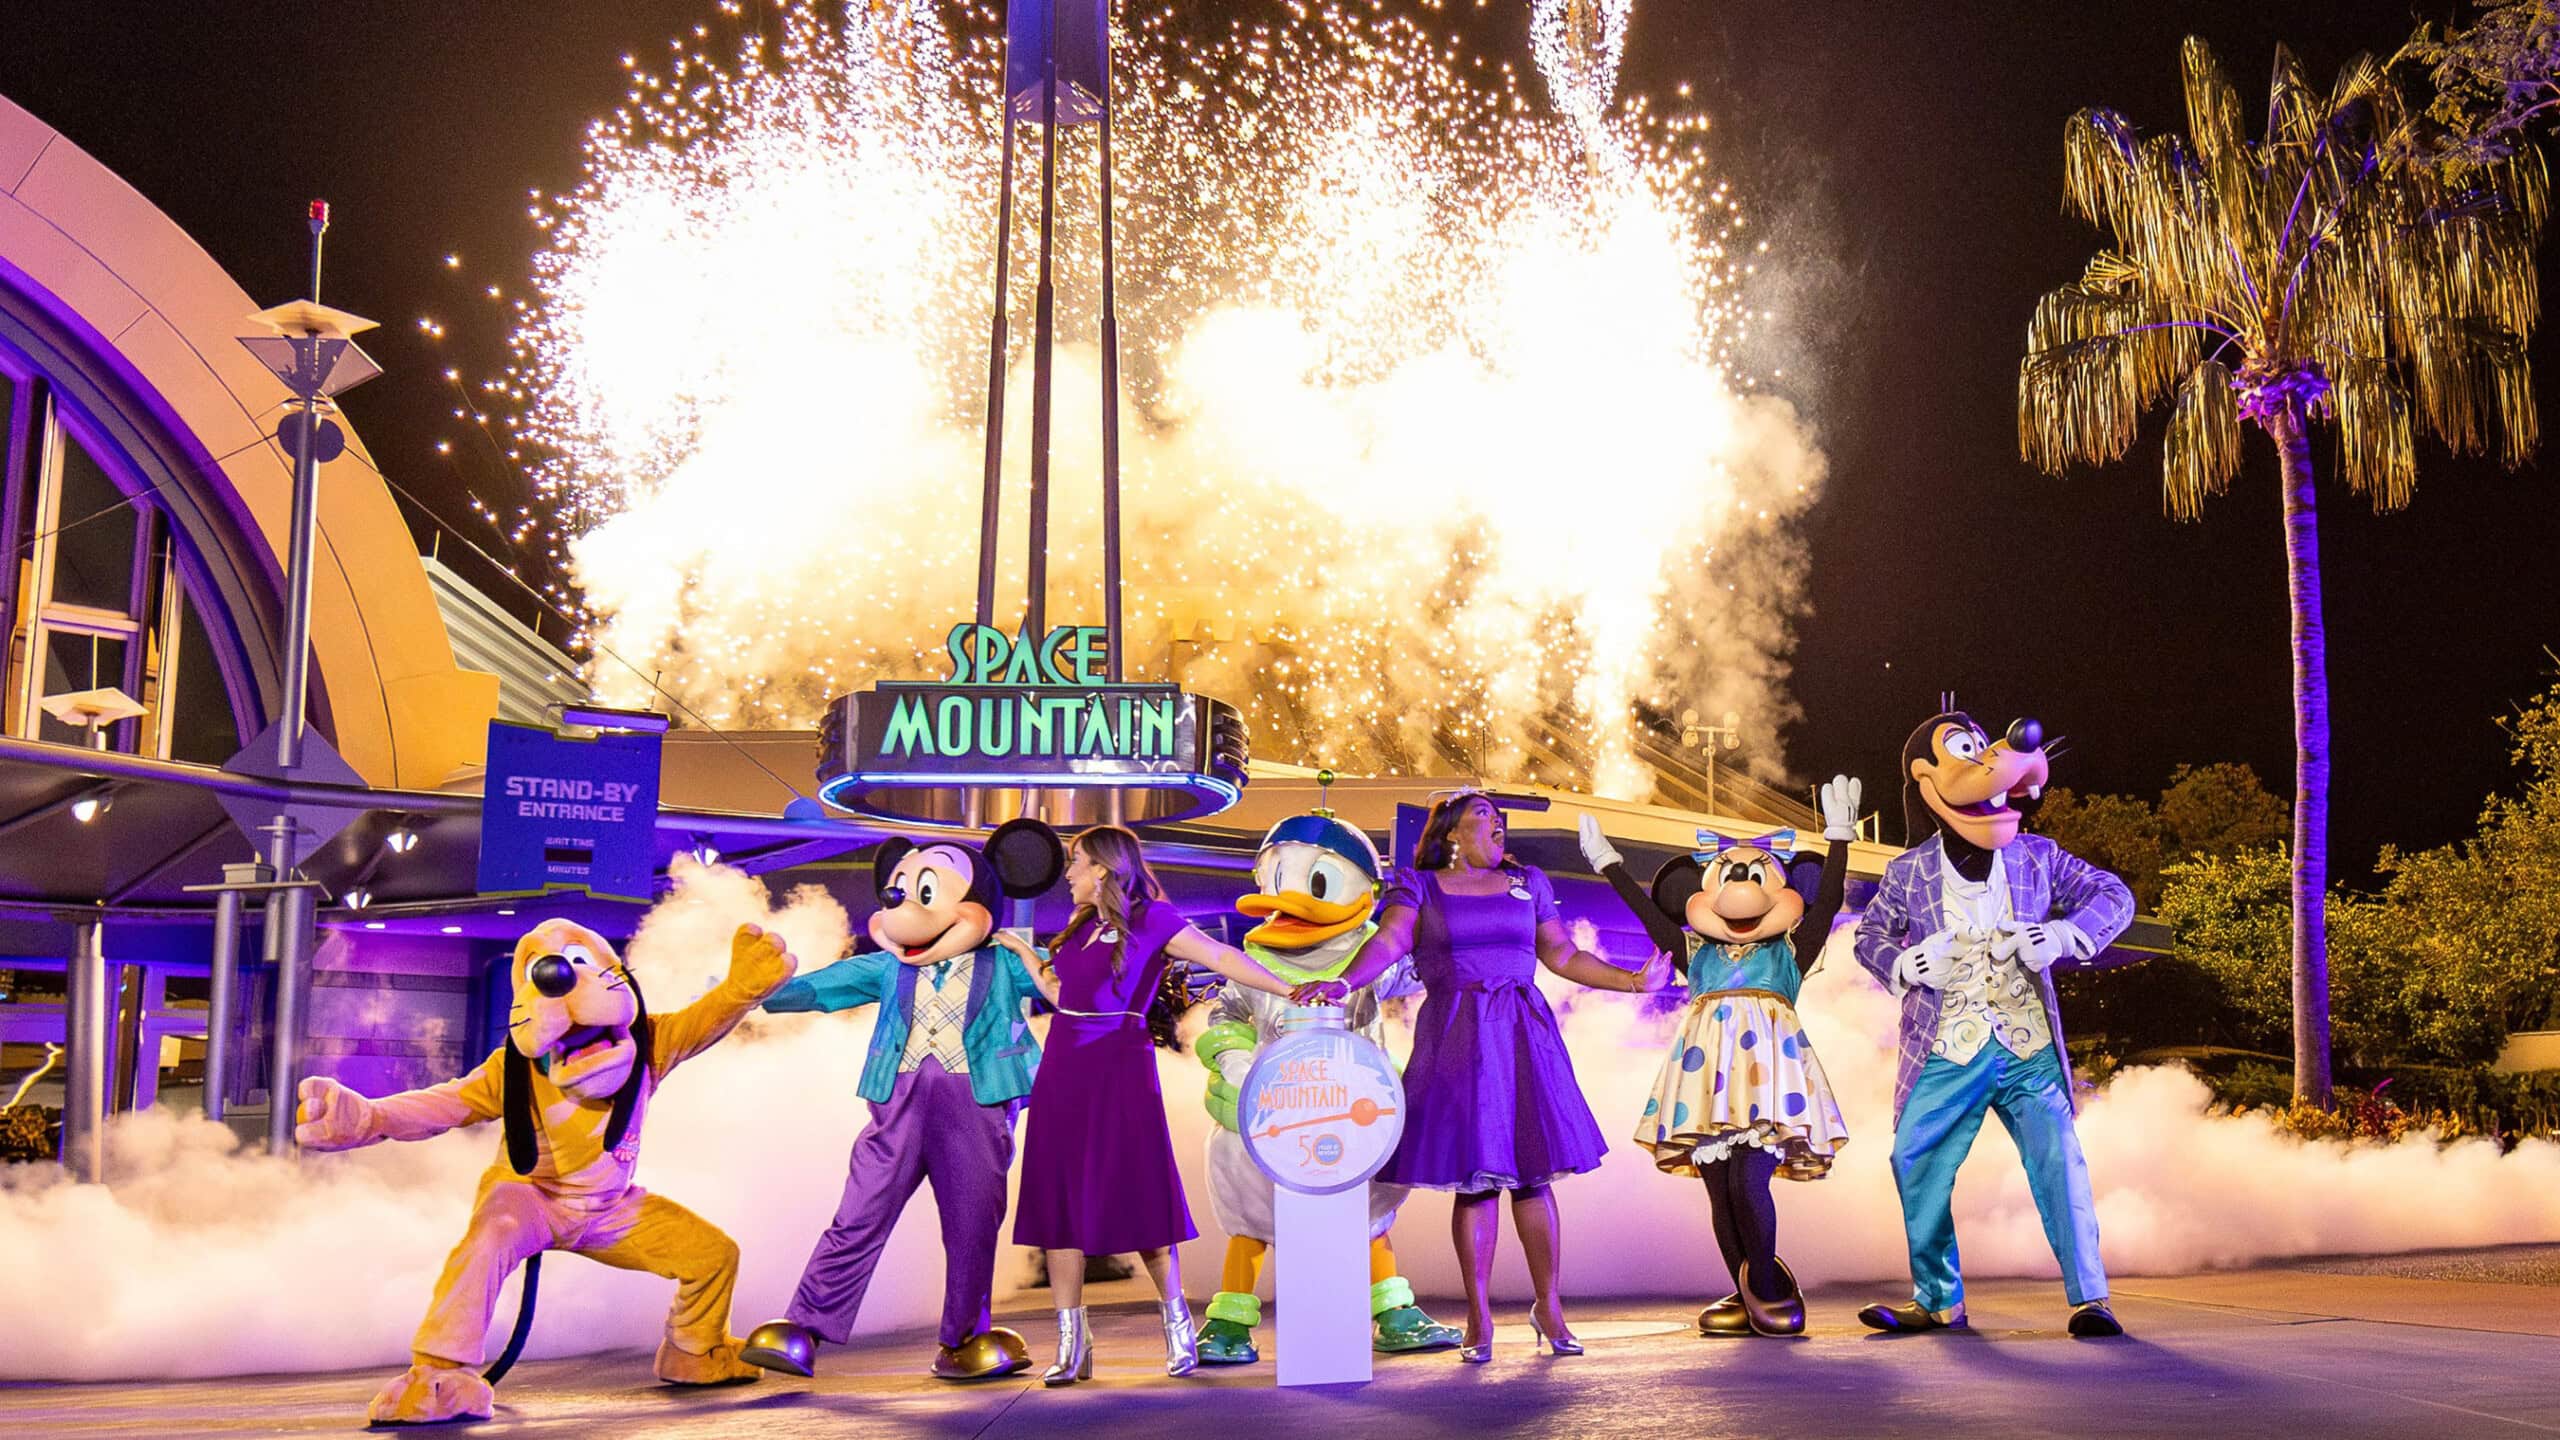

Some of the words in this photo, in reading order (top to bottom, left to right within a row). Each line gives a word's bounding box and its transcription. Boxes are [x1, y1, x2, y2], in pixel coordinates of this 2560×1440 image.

[947, 616, 1108, 686] SPACE
[880, 692, 1175, 760] MOUNTAIN
[505, 776, 640, 802] STAND-BY
[518, 801, 625, 822] ENTRANCE
[1279, 1059, 1328, 1082] SPACE
[1258, 1084, 1348, 1110] MOUNTAIN
[1298, 1134, 1344, 1167] 50
